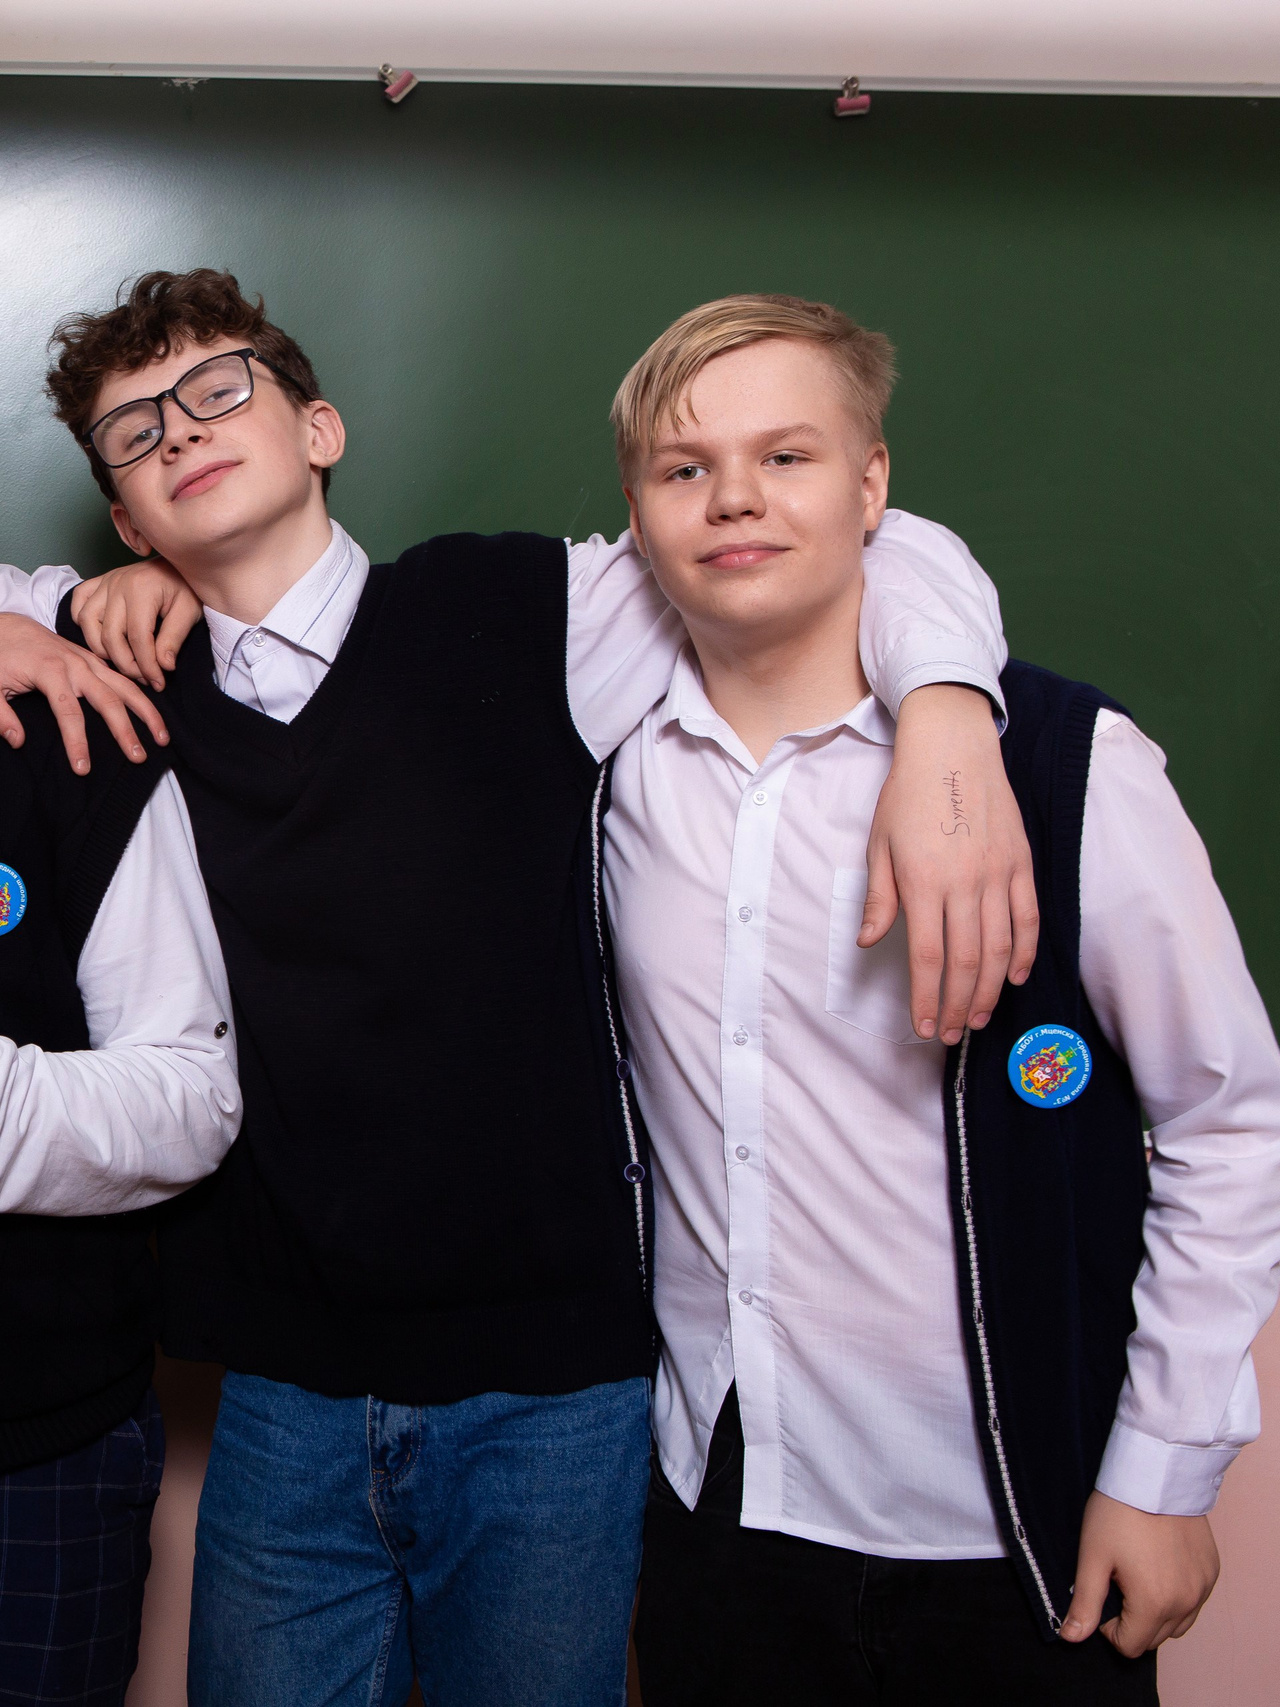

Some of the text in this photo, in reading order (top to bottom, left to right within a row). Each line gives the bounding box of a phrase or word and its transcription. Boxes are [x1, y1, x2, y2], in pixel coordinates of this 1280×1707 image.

[16, 879, 25, 903] школа
[1016, 1034, 1034, 1056] МБОУ
[1071, 1073, 1088, 1096] школа
